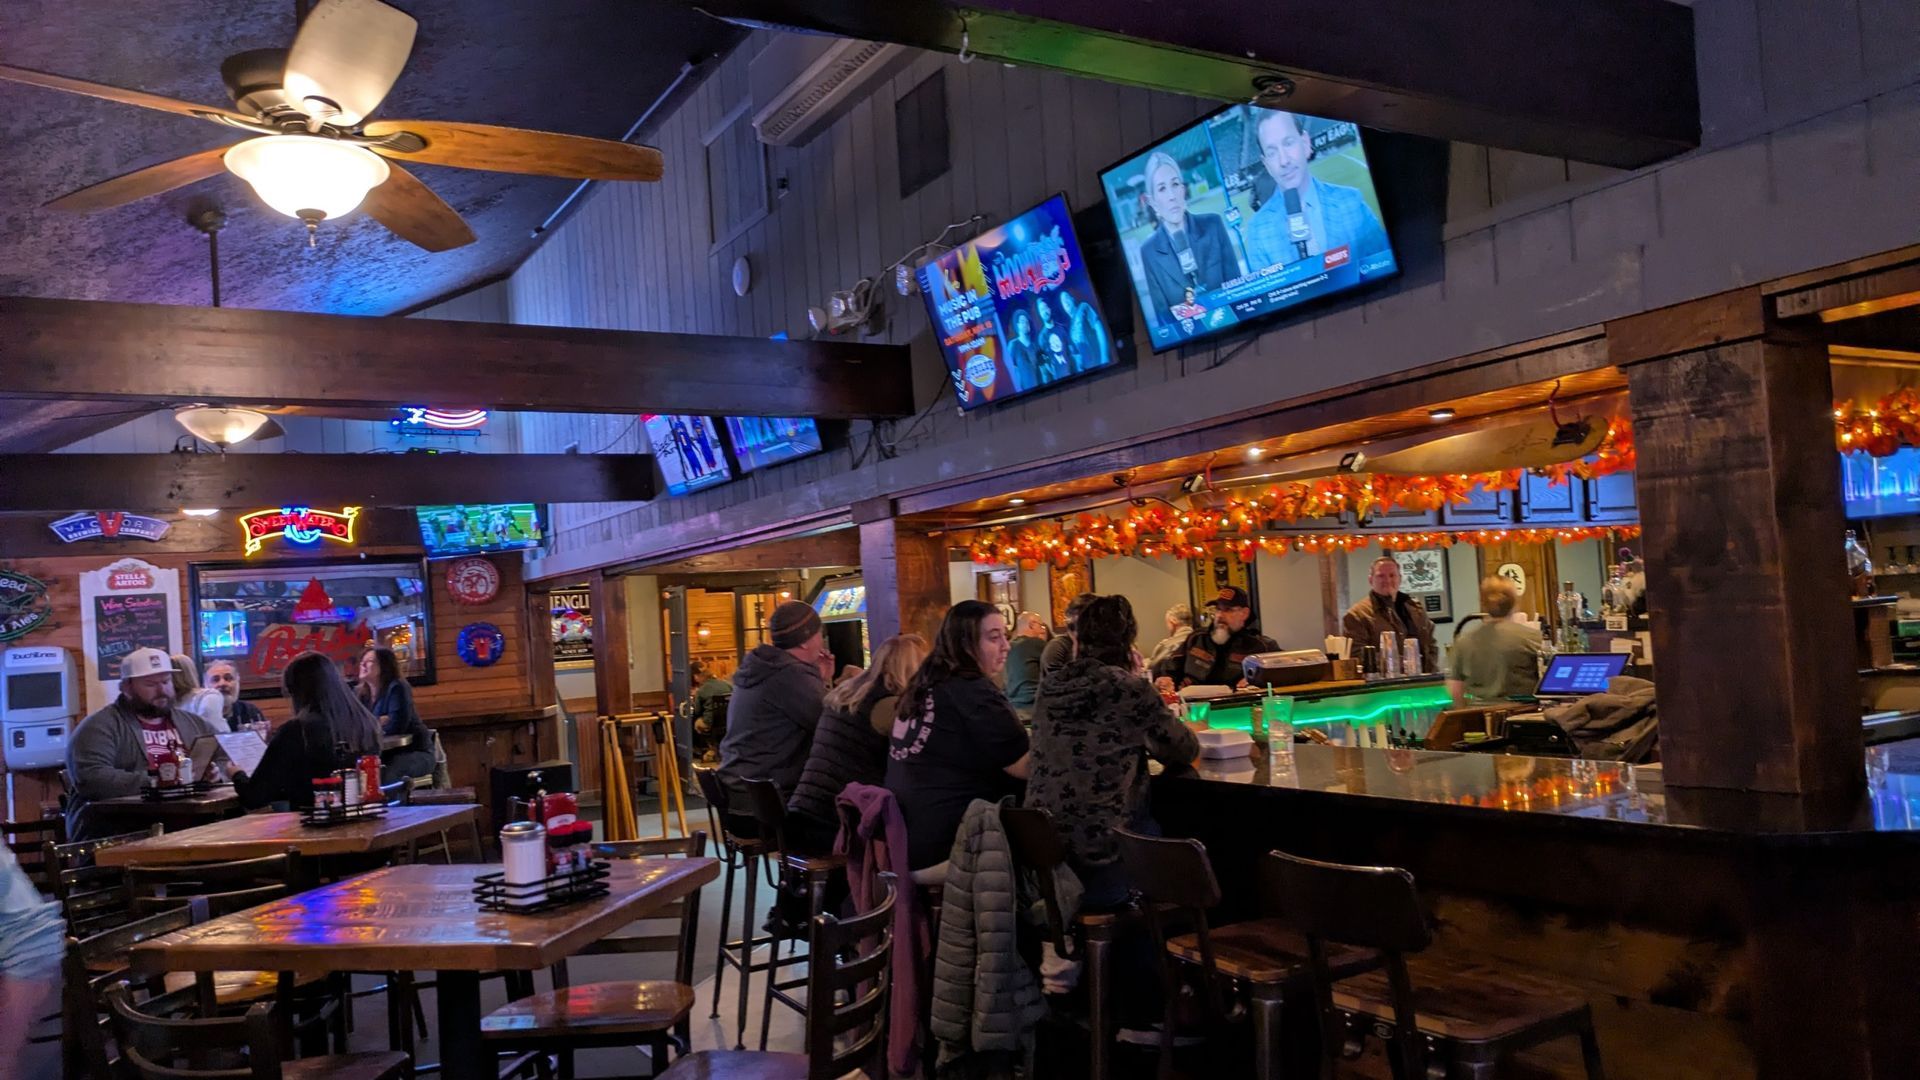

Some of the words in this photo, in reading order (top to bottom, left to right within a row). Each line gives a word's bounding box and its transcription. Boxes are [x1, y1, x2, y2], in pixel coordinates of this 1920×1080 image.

[1325, 249, 1348, 264] CHIEFS
[938, 295, 967, 316] MUSIC
[966, 289, 978, 303] IN
[944, 313, 963, 330] THE
[961, 306, 981, 323] PUB
[0, 578, 28, 592] ead
[12, 612, 39, 630] Ales
